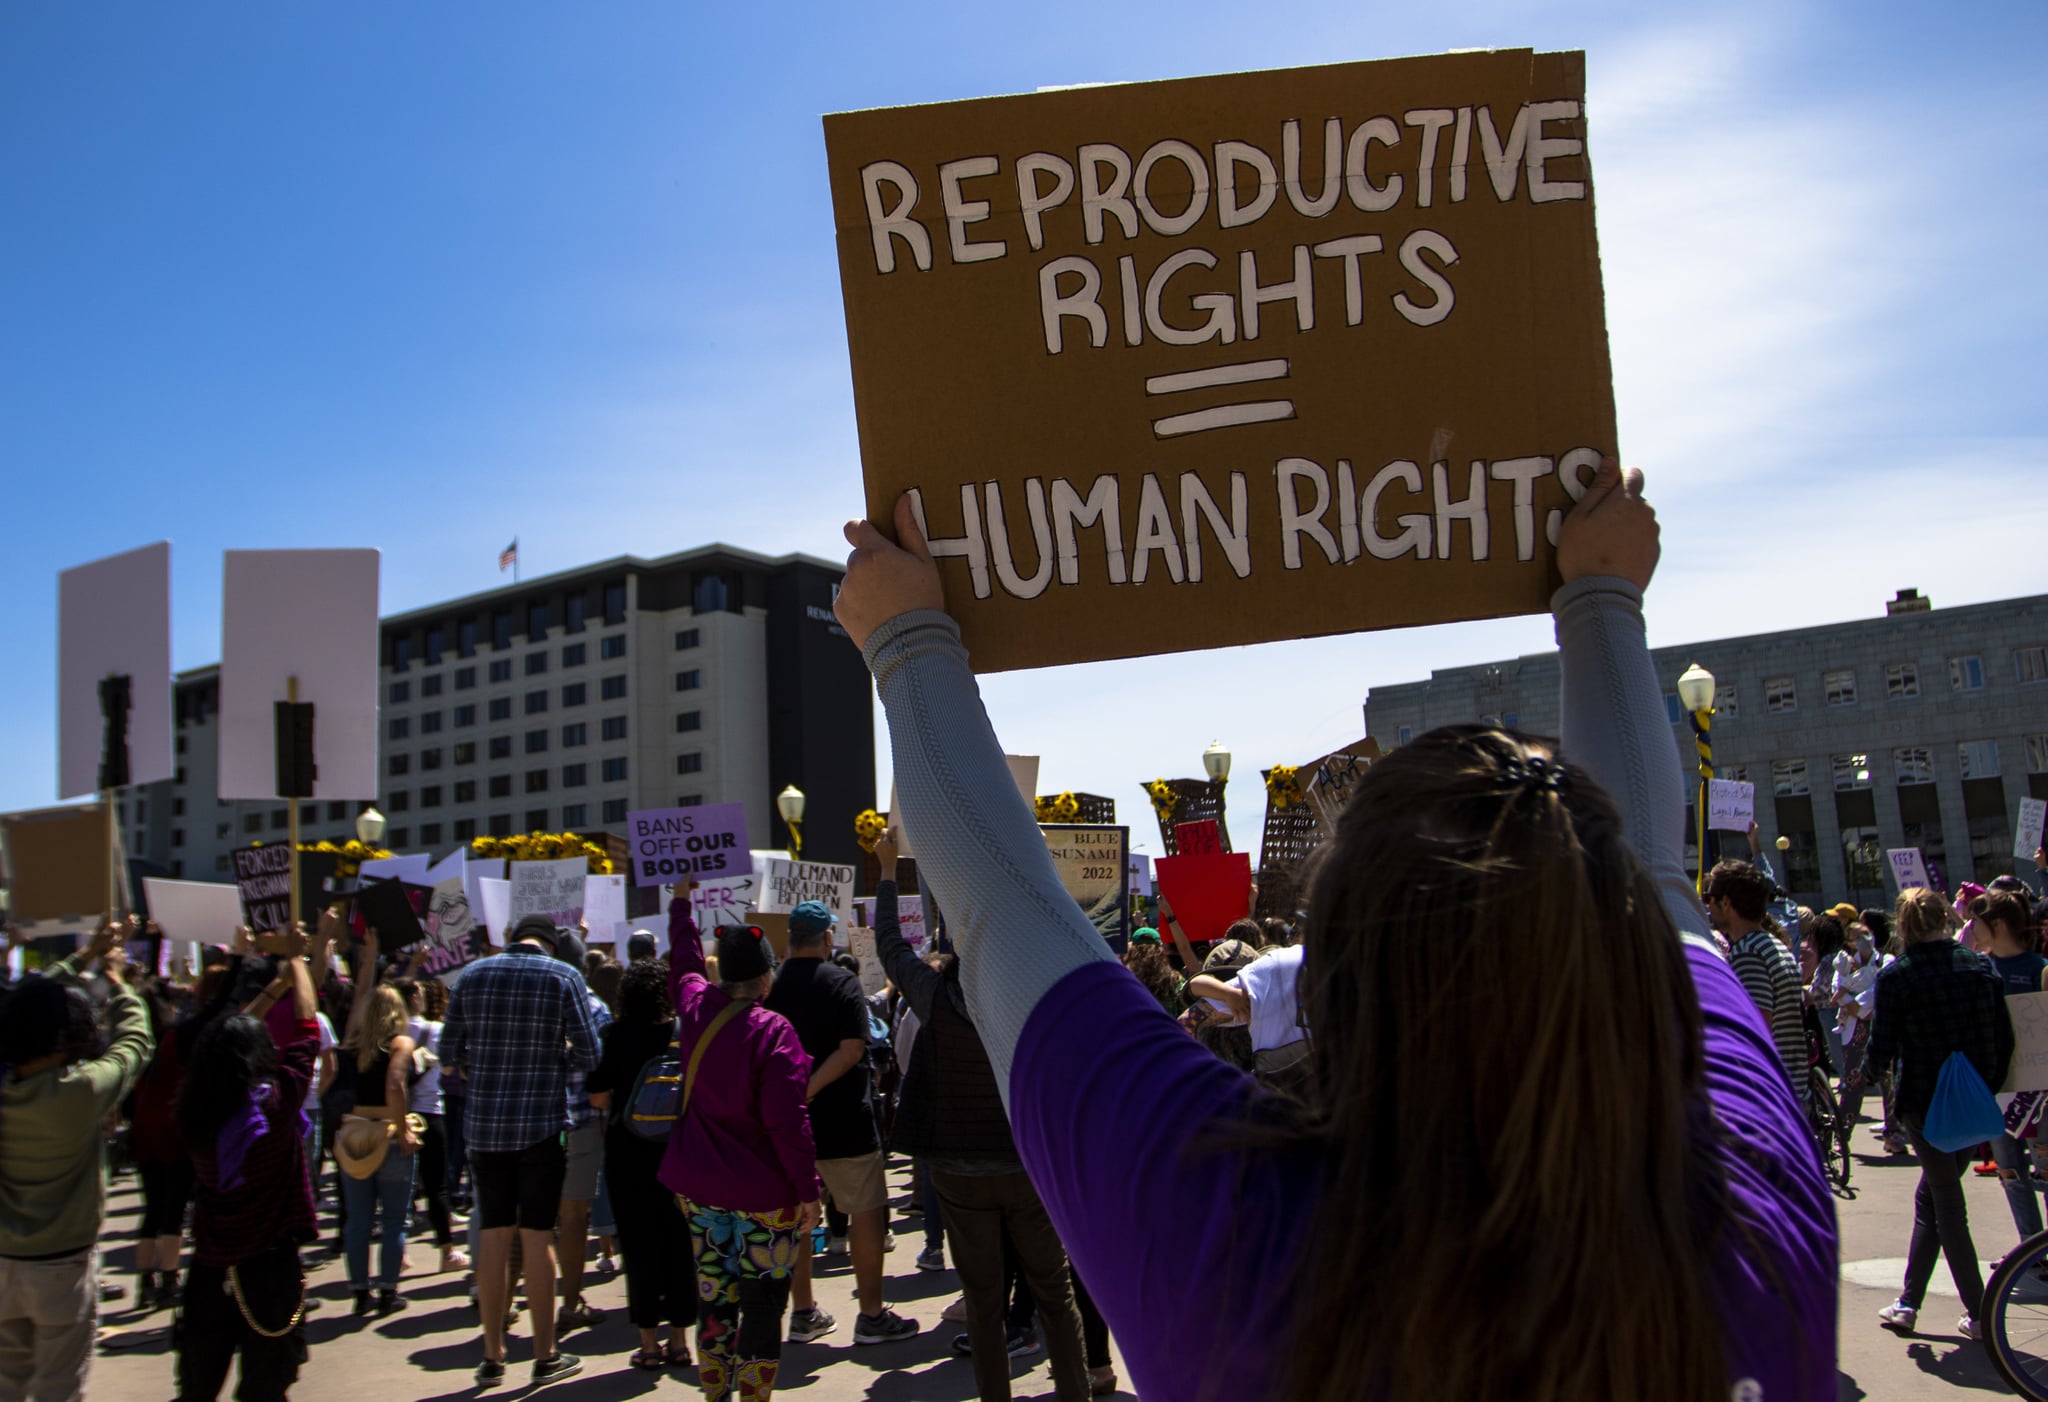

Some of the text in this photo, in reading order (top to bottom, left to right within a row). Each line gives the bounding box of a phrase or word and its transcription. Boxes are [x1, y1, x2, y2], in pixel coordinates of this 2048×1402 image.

[859, 100, 1586, 275] REPRODUCTIVE
[1039, 228, 1461, 355] RIGHTS
[904, 469, 1252, 600] HUMAN
[637, 816, 694, 837] BANS
[640, 832, 736, 857] OFF OUR
[1074, 833, 1119, 845] BLUE
[236, 844, 290, 877] FORCED
[642, 853, 727, 877] BODIES
[1049, 848, 1117, 861] SUNAMI
[788, 862, 854, 885] DEMAND
[1082, 866, 1113, 880] 2022
[693, 887, 737, 912] HER
